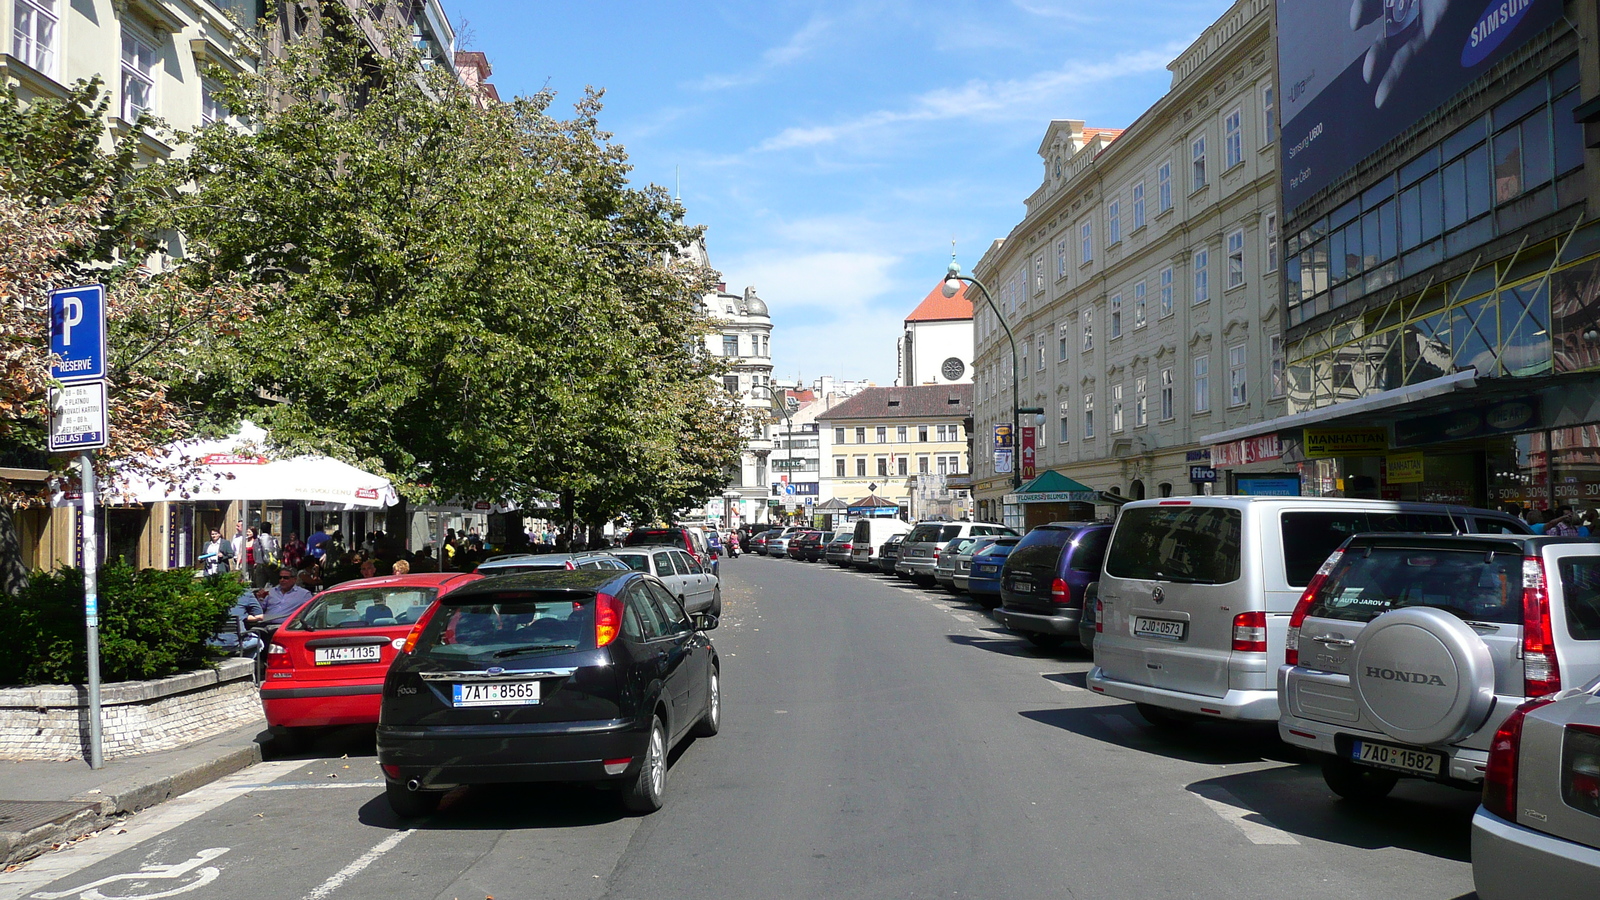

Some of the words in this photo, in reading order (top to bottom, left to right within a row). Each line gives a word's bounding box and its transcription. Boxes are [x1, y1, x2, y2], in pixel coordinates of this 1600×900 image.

[1289, 136, 1309, 159] Samsung
[1309, 122, 1323, 141] U600
[1290, 177, 1299, 190] Petr
[63, 297, 84, 346] P
[59, 357, 92, 372] RÉSERVÉ
[81, 405, 100, 413] KARTOU
[54, 434, 84, 443] OBLAST
[91, 432, 97, 440] 3
[1308, 433, 1385, 445] MANHATTAN
[1258, 436, 1278, 459] SALE
[1388, 459, 1421, 471] MANHATTAN
[1192, 467, 1215, 479] firo
[1499, 488, 1519, 499] 50%
[1526, 487, 1548, 498] 30%
[1555, 485, 1579, 497] 50%
[1586, 484, 1600, 496] 30
[1358, 599, 1383, 607] JAROV
[1160, 622, 1180, 635] 0573
[324, 647, 342, 660] 1A4
[350, 646, 375, 658] 1135
[1366, 666, 1446, 687] HONDA
[465, 685, 488, 700] 7A1
[500, 683, 533, 699] 8565
[1400, 750, 1435, 771] 1582
